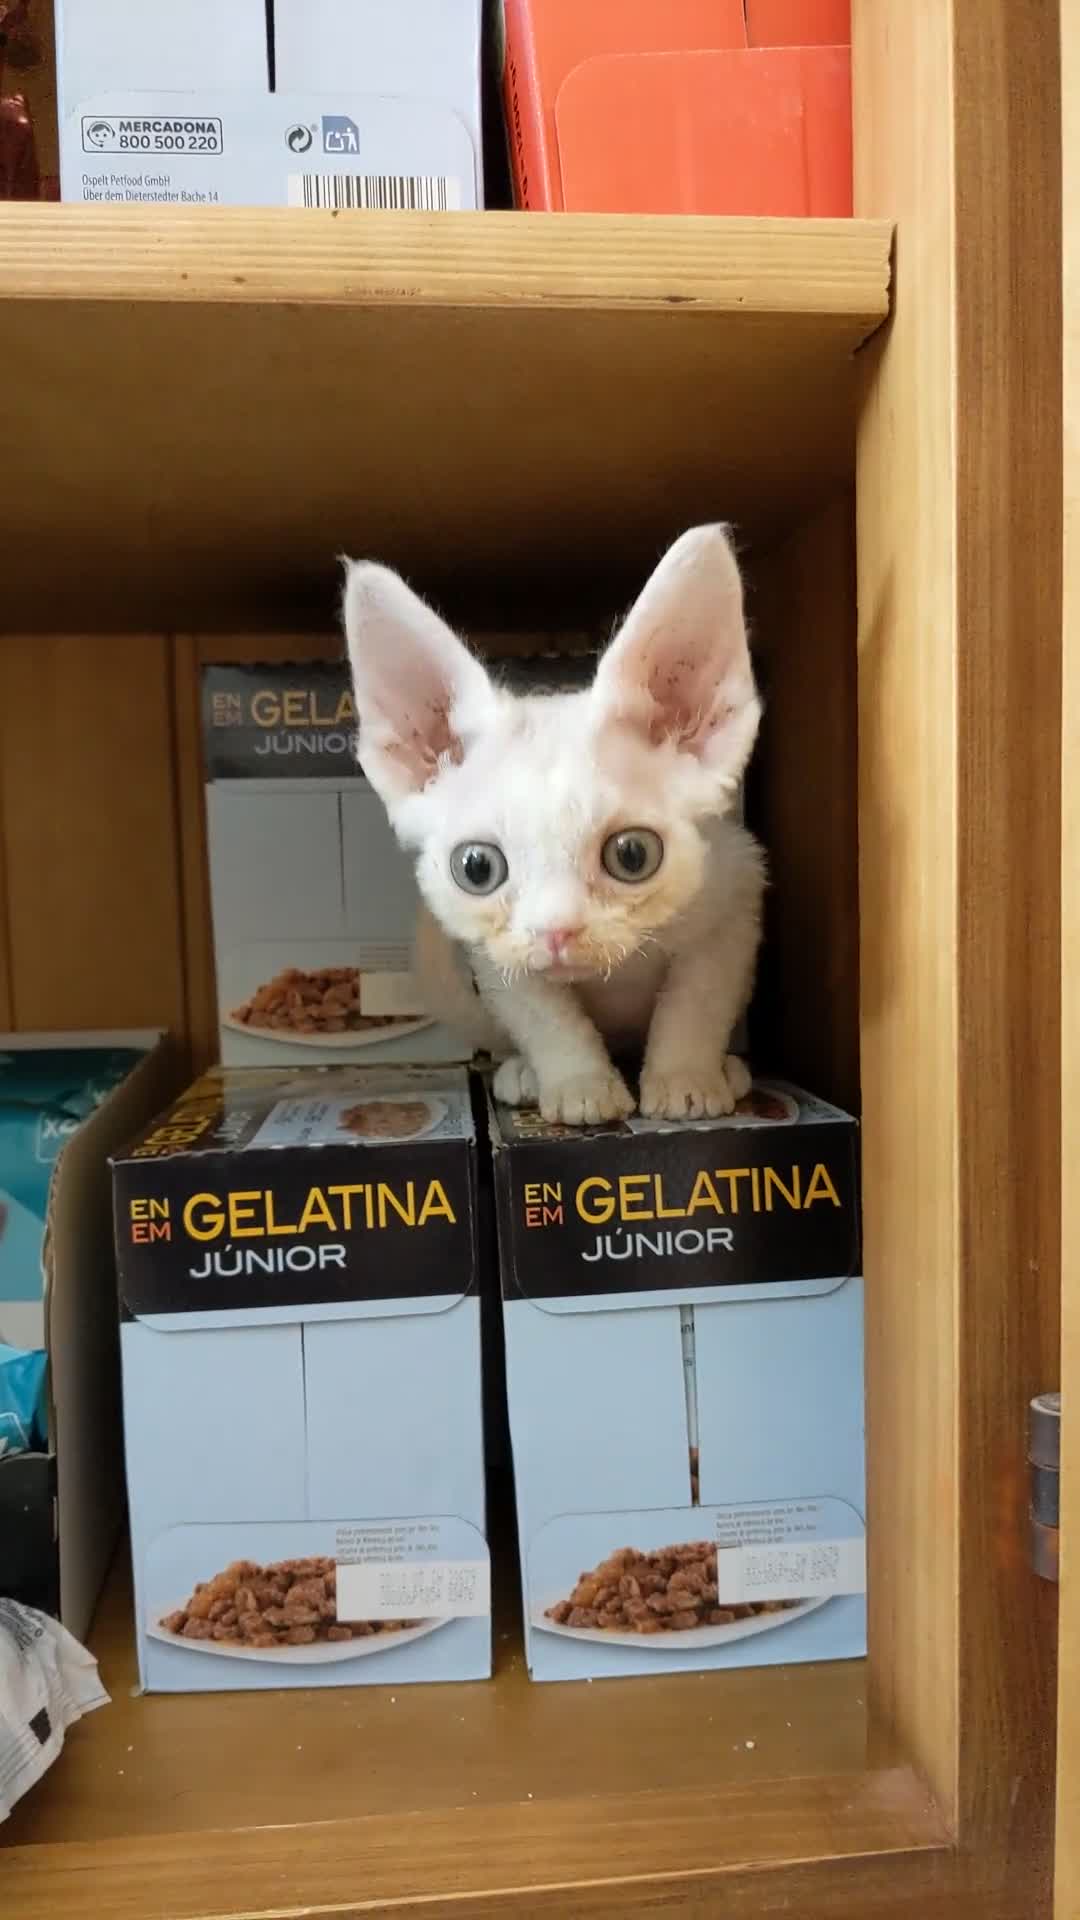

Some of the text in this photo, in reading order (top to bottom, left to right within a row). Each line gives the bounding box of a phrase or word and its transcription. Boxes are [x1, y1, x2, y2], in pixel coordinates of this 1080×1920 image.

[119, 121, 216, 134] MERCADONA
[119, 135, 218, 150] 800 500 220
[82, 174, 171, 188] Ospelt Petfood GmbH
[105, 189, 123, 201] dem
[181, 190, 206, 202] Bache
[208, 191, 218, 202] 14
[213, 692, 241, 708] EN
[524, 1182, 562, 1205] EN
[575, 1163, 841, 1225] GELATINA
[130, 1198, 170, 1221] EN
[182, 1179, 457, 1242] GELATINA
[526, 1205, 565, 1228] EM
[131, 1221, 172, 1245] EM
[581, 1227, 734, 1263] JÚNIOR
[189, 1244, 348, 1279] JÚNIOR
